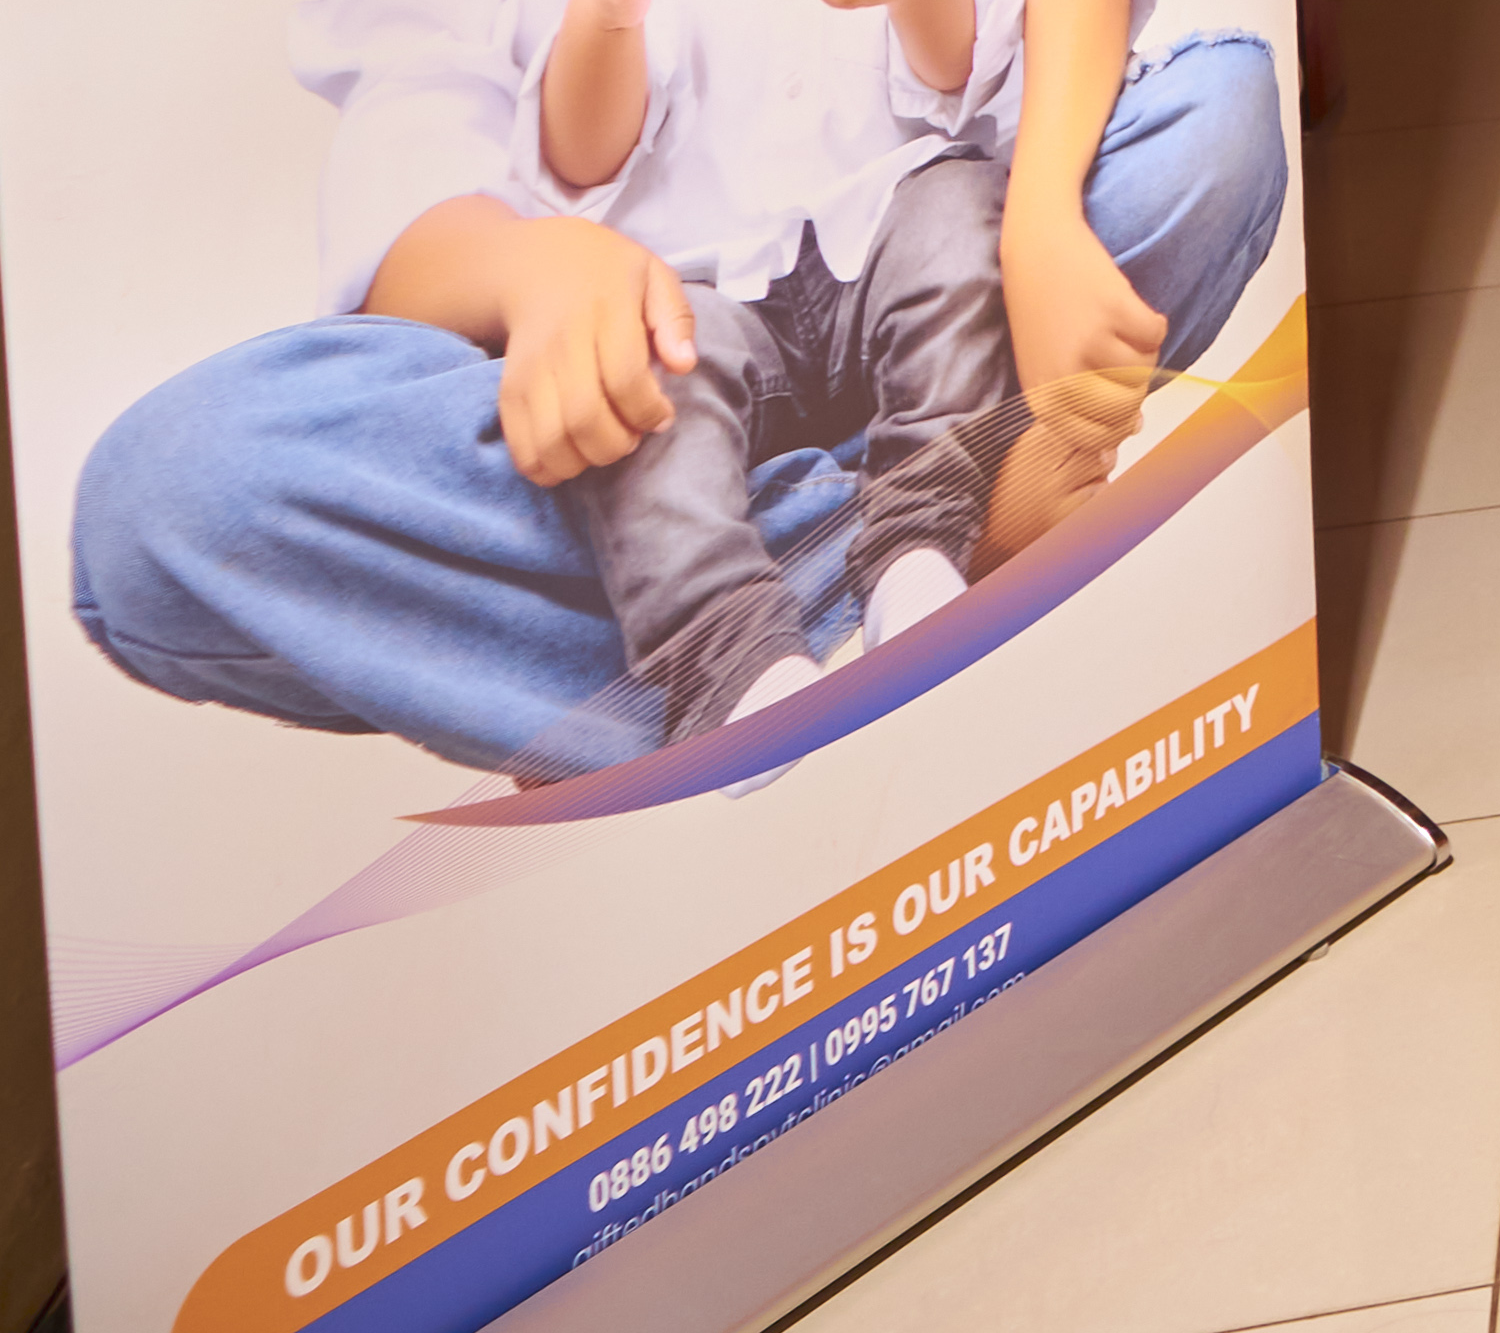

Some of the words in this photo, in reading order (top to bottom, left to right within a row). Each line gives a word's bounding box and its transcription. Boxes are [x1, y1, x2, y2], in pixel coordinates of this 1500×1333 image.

[285, 1176, 428, 1298] OUR
[446, 945, 815, 1202] CONFIDENCE
[829, 911, 879, 978] IS
[893, 840, 997, 935] OUR
[1008, 684, 1259, 868] CAPABILITY
[589, 1134, 673, 1213] 0886
[678, 1093, 738, 1155] 498
[745, 1054, 802, 1118] 222
[824, 994, 897, 1066] 0995
[903, 959, 955, 1019] 767
[961, 922, 1012, 978] 137
